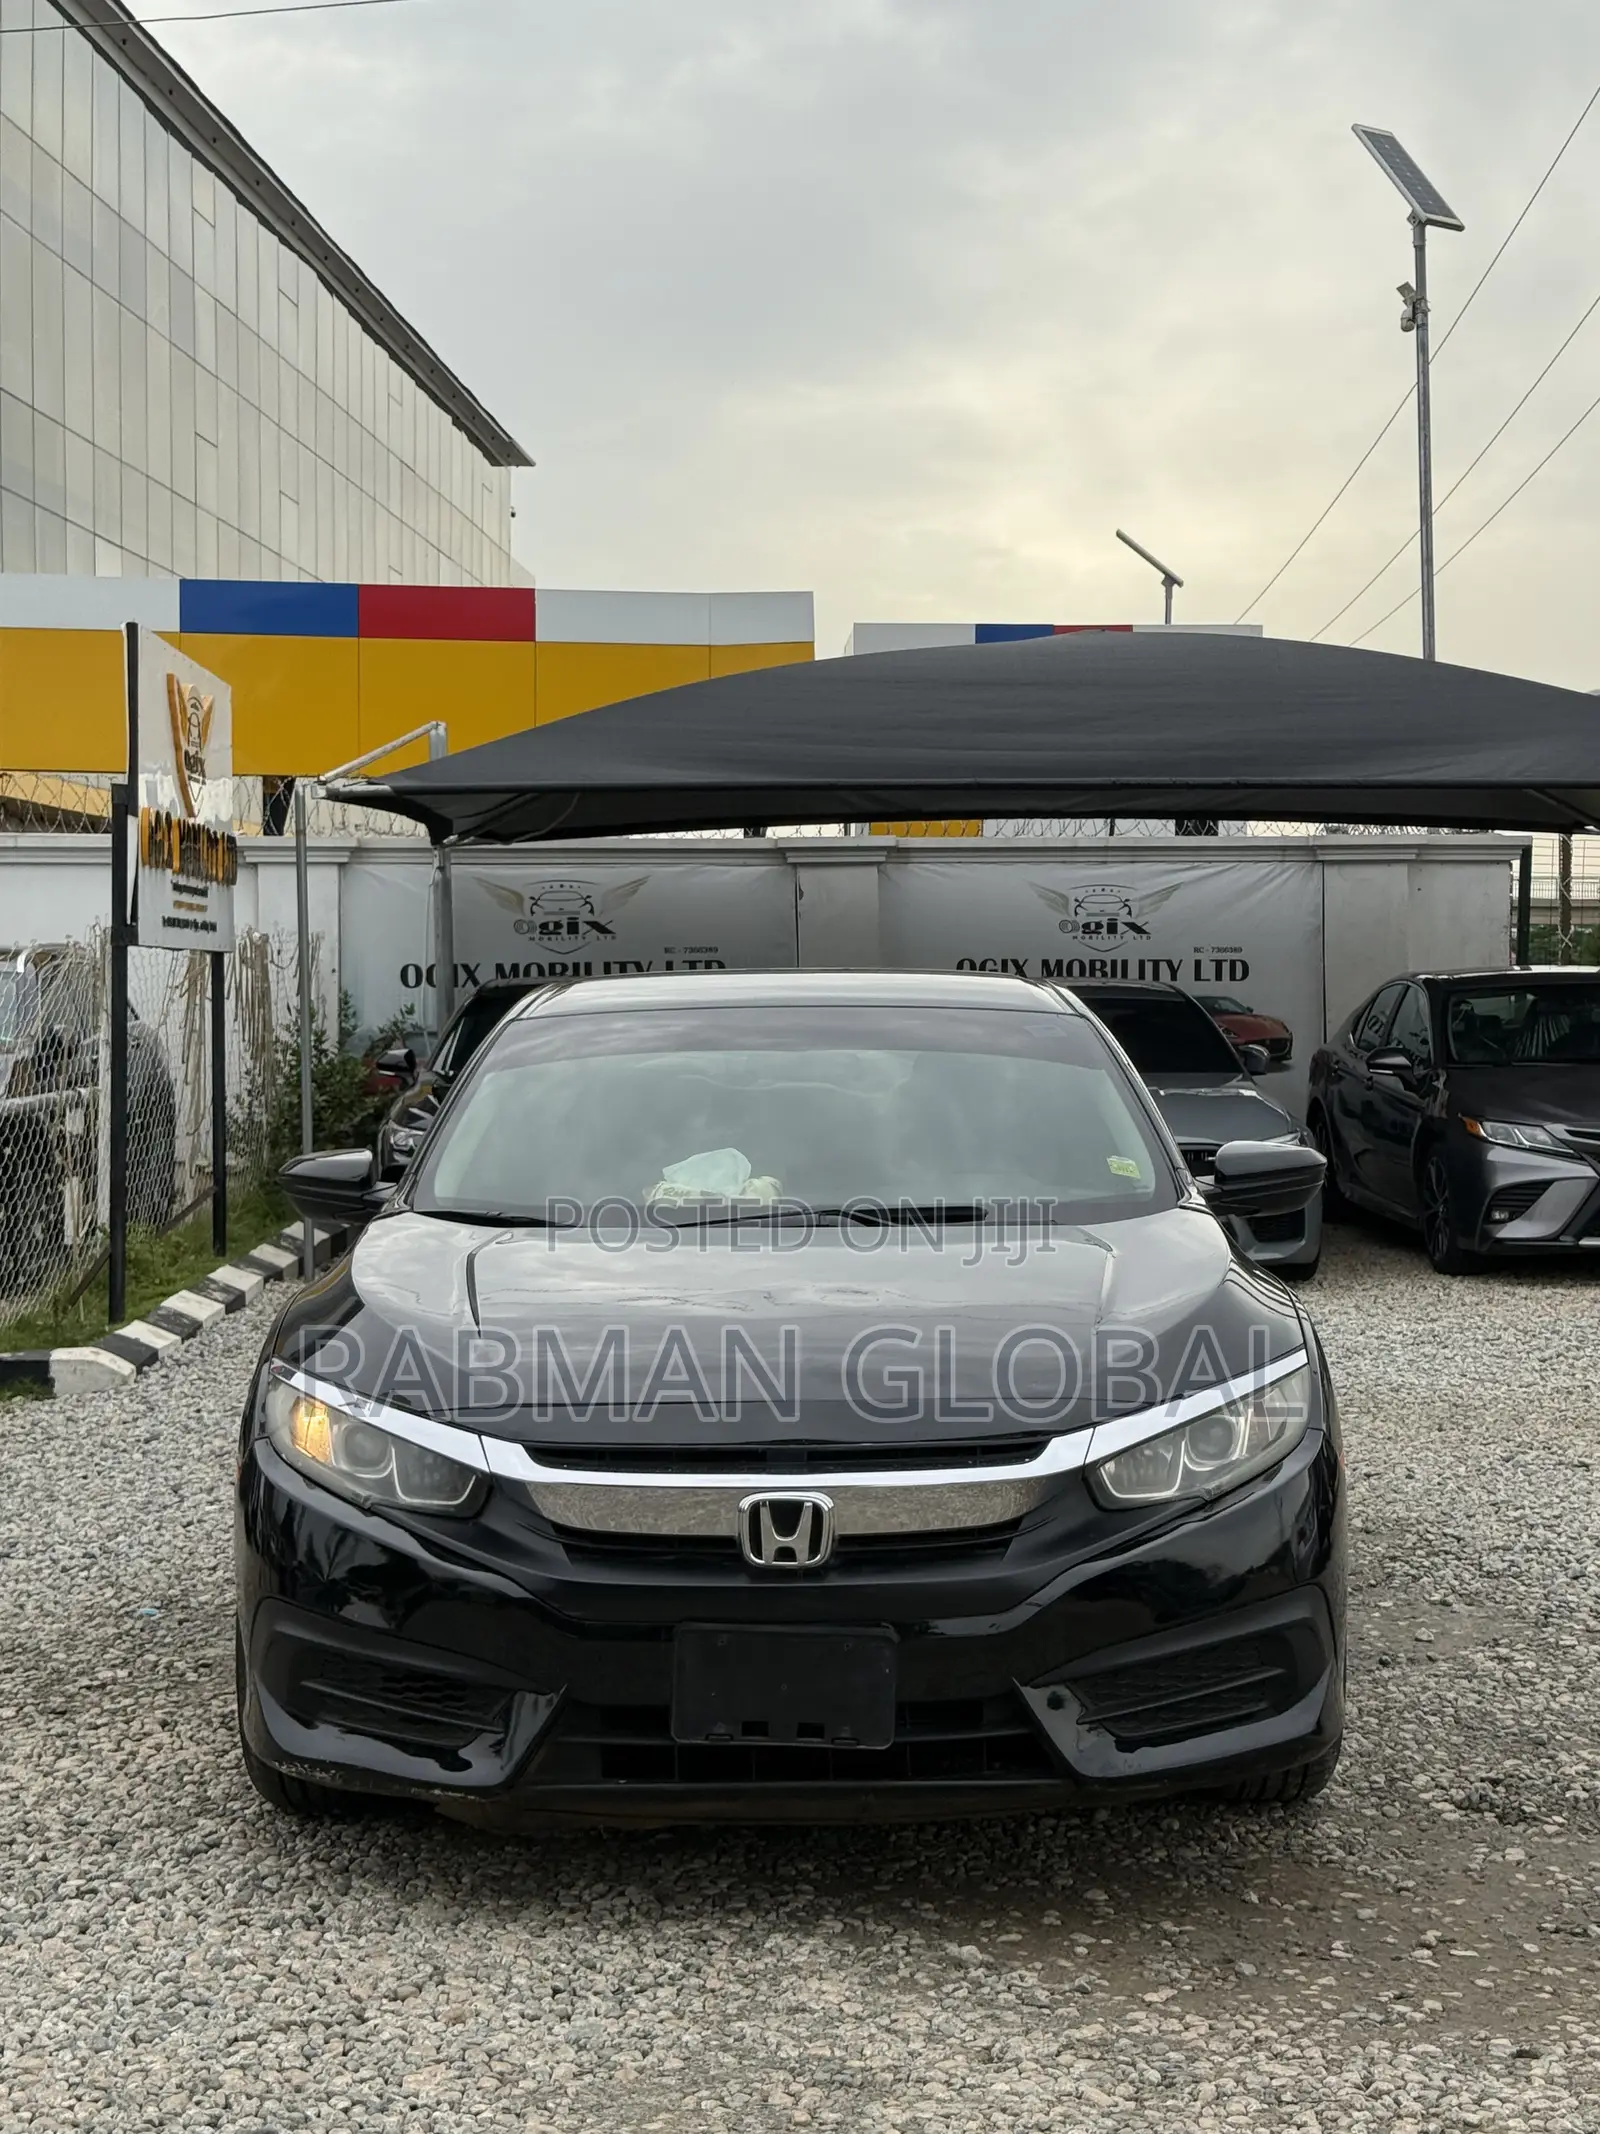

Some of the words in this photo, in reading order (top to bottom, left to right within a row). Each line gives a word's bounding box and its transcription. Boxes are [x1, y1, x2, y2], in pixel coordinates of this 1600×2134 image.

[1193, 946, 1205, 954] RC
[1041, 959, 1183, 982] MOBILITY
[1194, 959, 1250, 982] LTD
